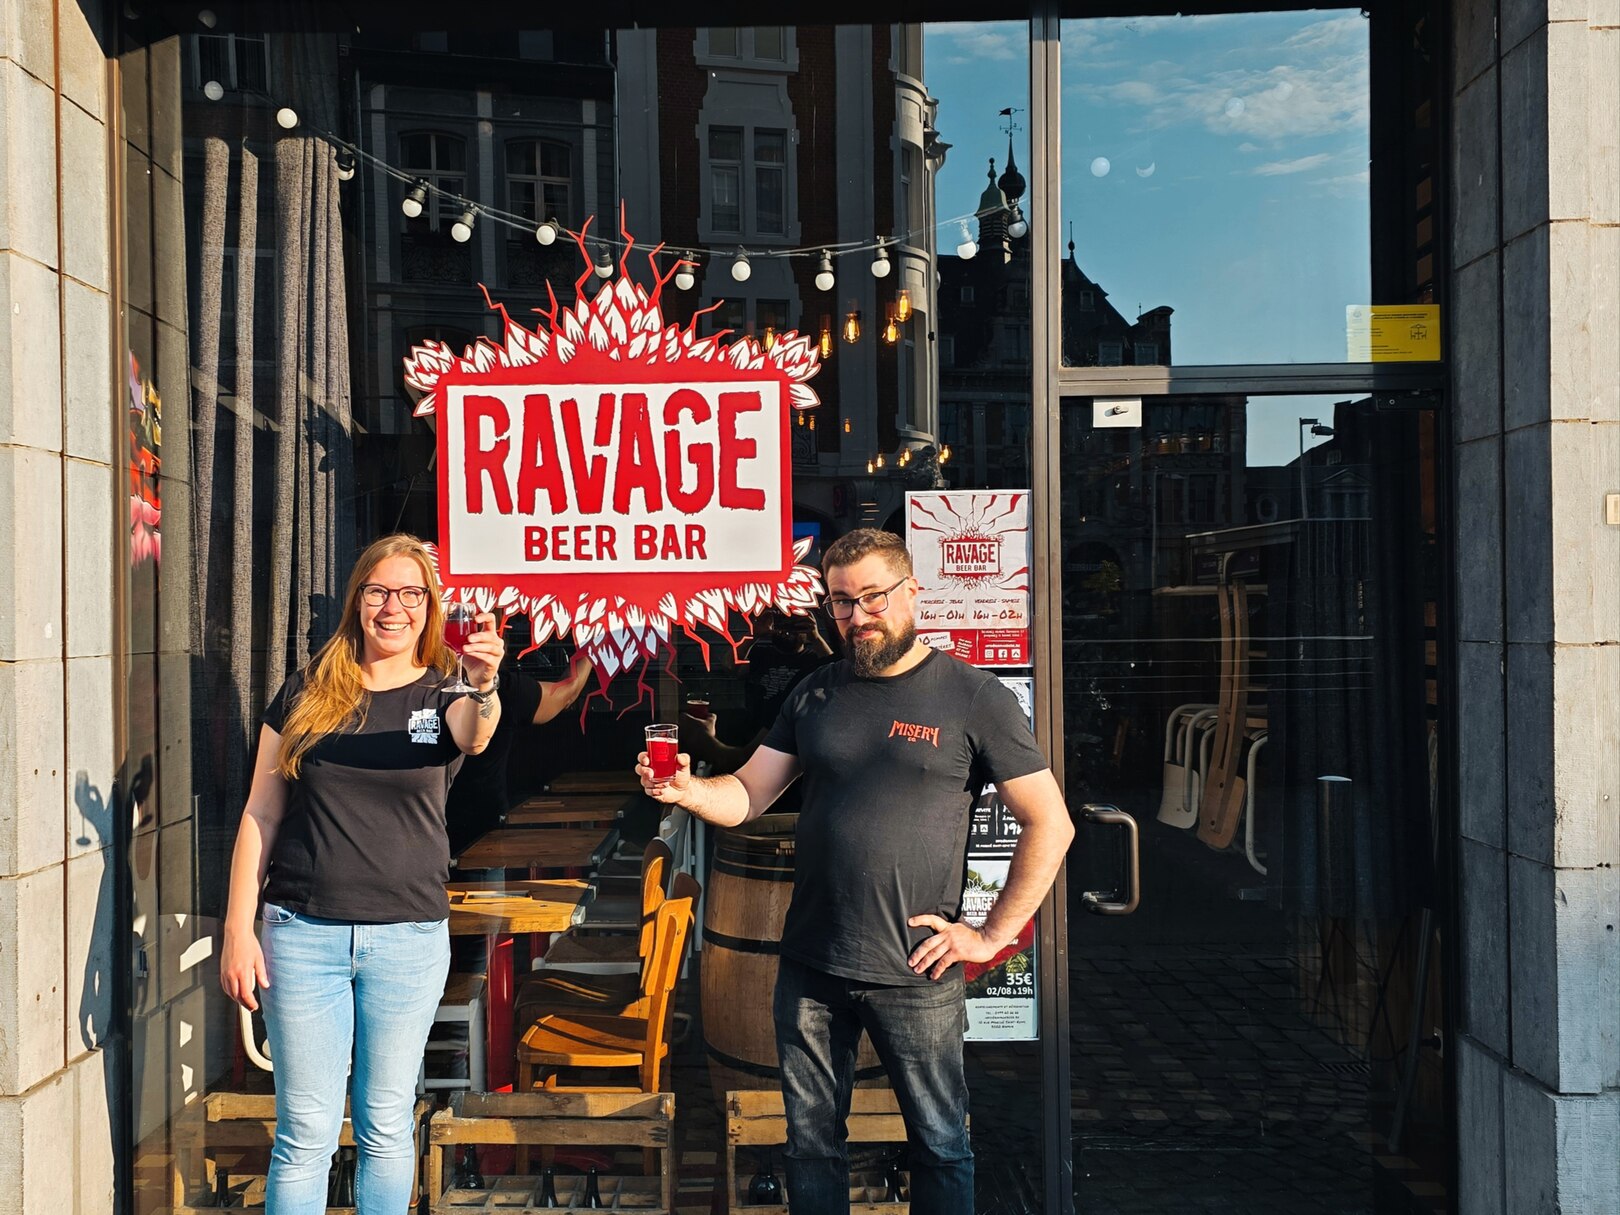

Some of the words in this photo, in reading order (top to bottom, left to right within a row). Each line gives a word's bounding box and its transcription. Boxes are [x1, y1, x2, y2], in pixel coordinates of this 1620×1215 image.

[463, 388, 766, 515] RAVAGE
[524, 524, 617, 561] BEER
[634, 523, 708, 561] BAR
[946, 543, 996, 564] RAVAGE
[410, 718, 438, 730] RAVAGE
[888, 719, 940, 748] MISERY
[1006, 972, 1033, 986] 35€
[986, 987, 1012, 996] 02/08
[1017, 986, 1033, 995] 19h
